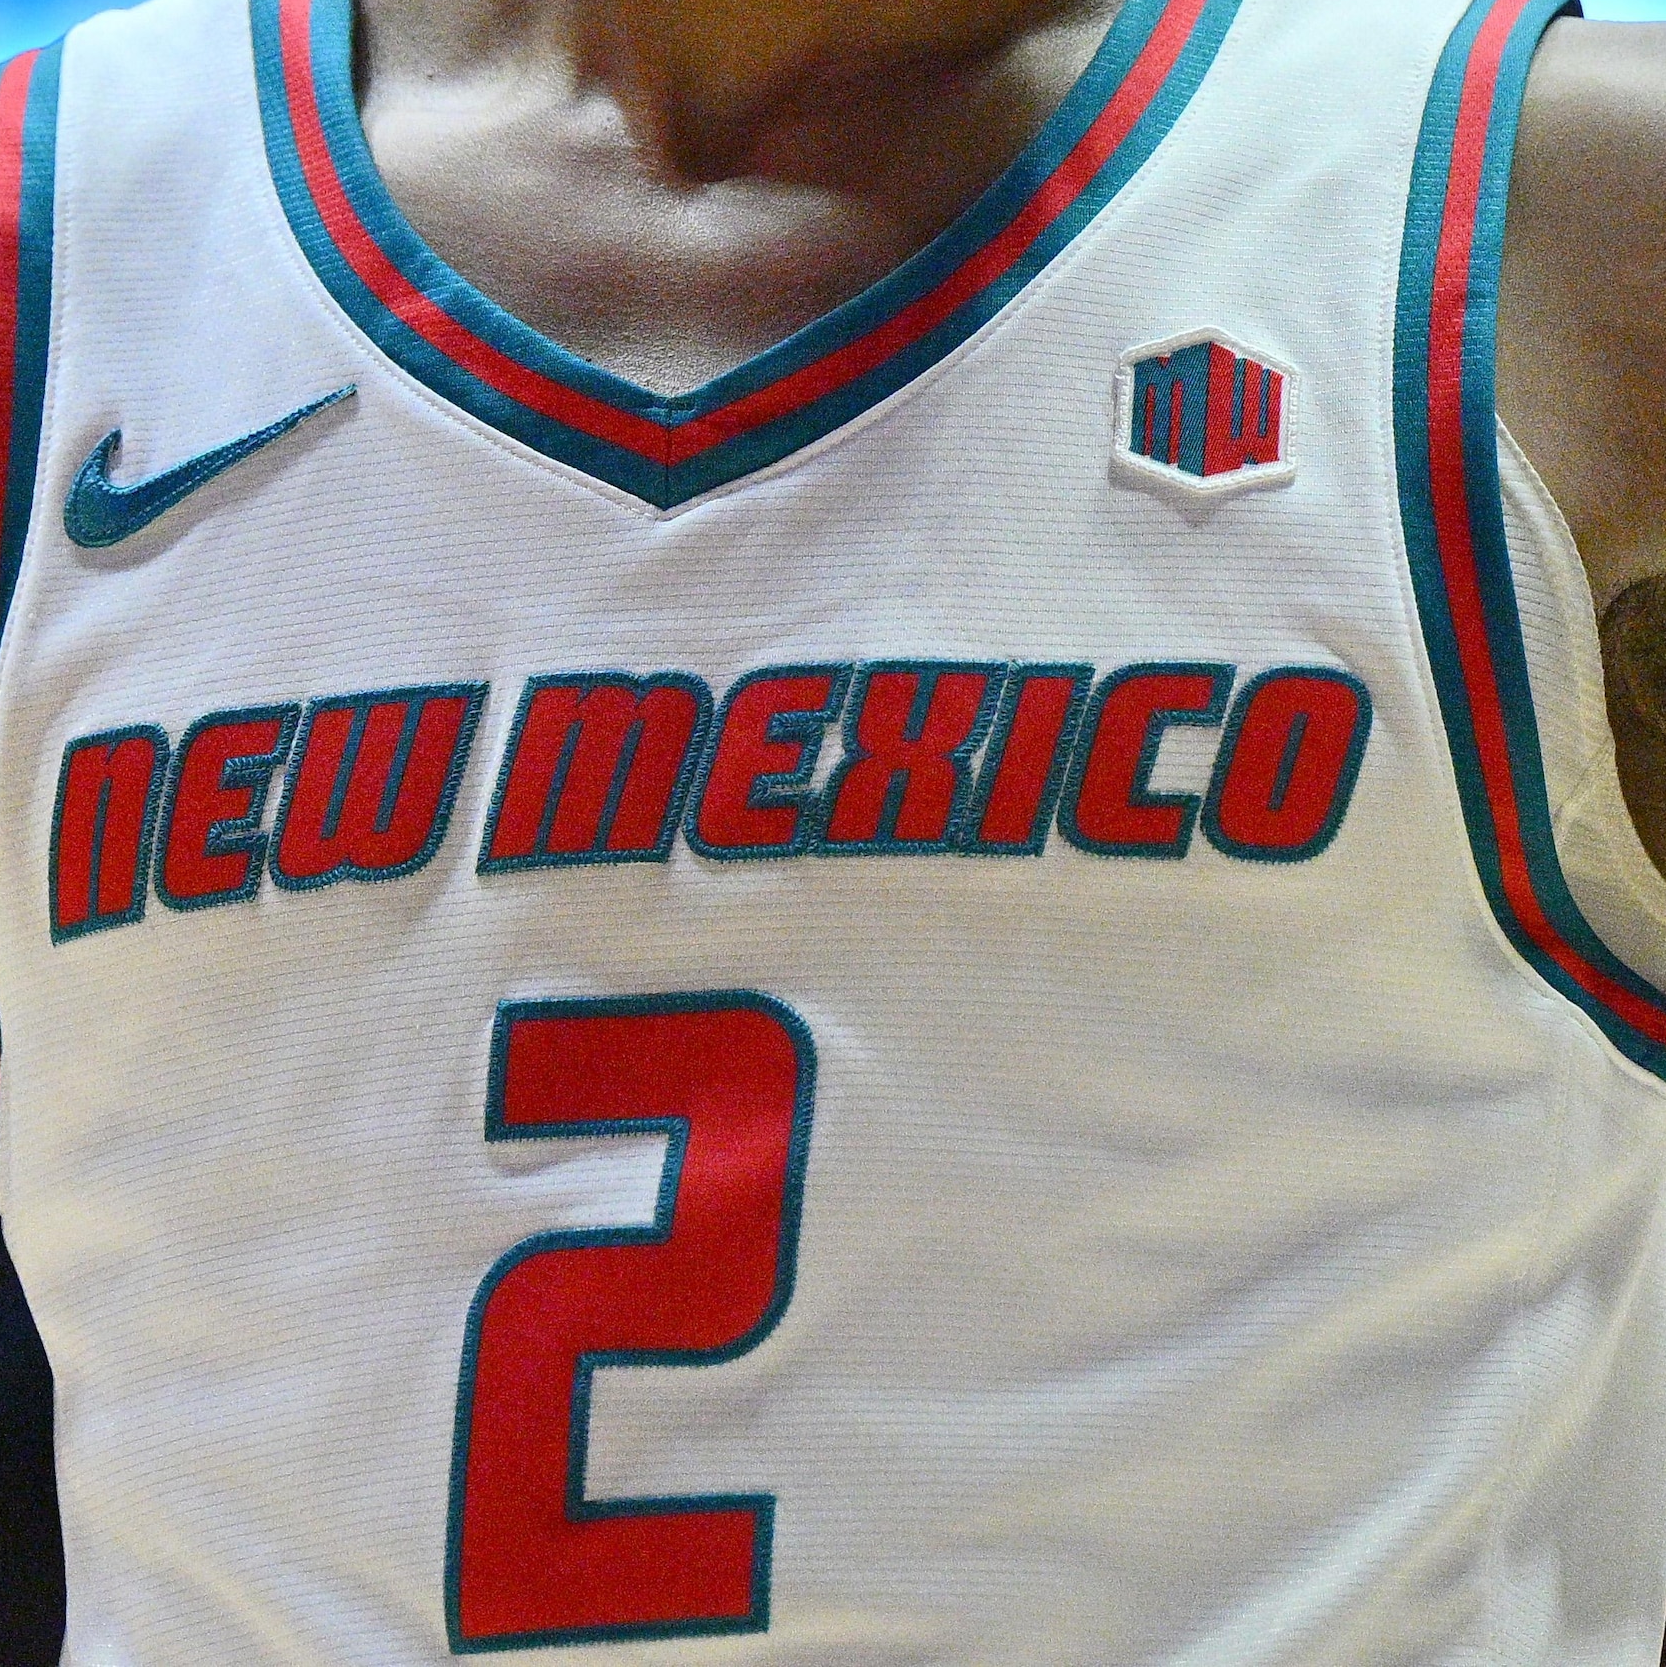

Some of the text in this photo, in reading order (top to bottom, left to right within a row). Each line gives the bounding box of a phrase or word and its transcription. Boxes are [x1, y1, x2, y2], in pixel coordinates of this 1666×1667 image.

[1129, 341, 1284, 477] MW
[50, 661, 1373, 944] NEW MEXICO
[448, 990, 816, 1654] 2
